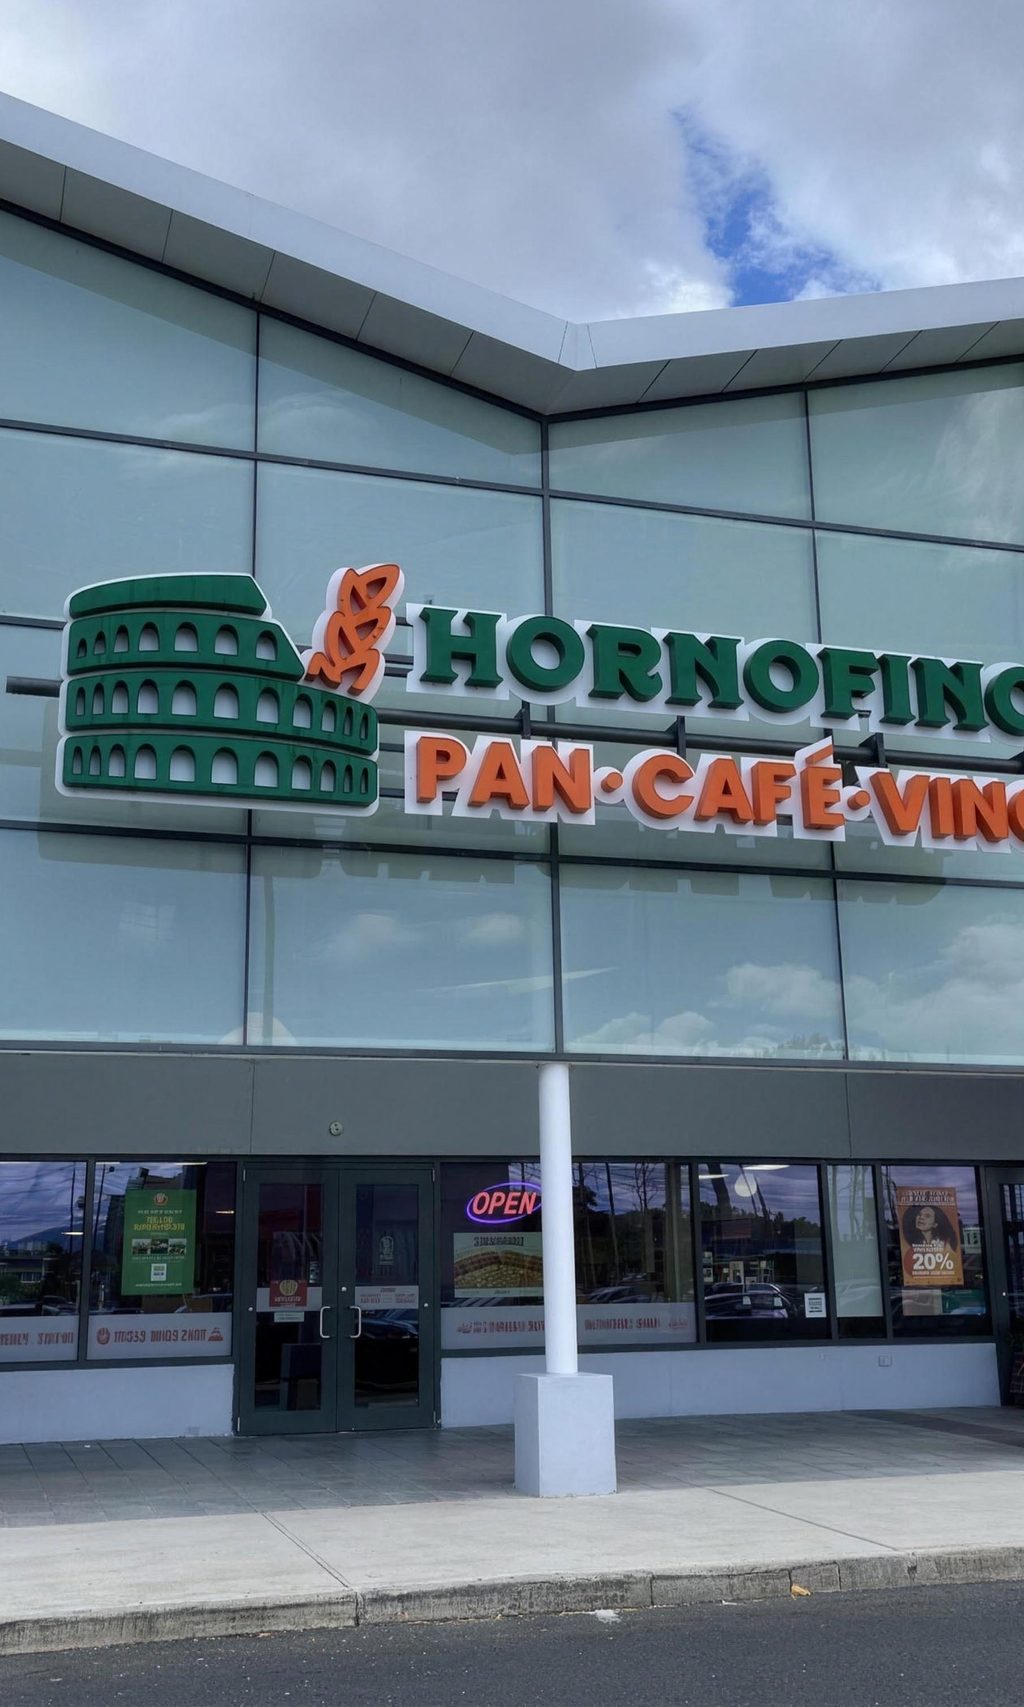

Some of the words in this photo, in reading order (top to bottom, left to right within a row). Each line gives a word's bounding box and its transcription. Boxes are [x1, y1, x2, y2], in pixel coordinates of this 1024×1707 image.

[870, 771, 1024, 844] VIN
[472, 1191, 537, 1215] OPEN
[912, 1253, 954, 1270] 20%
